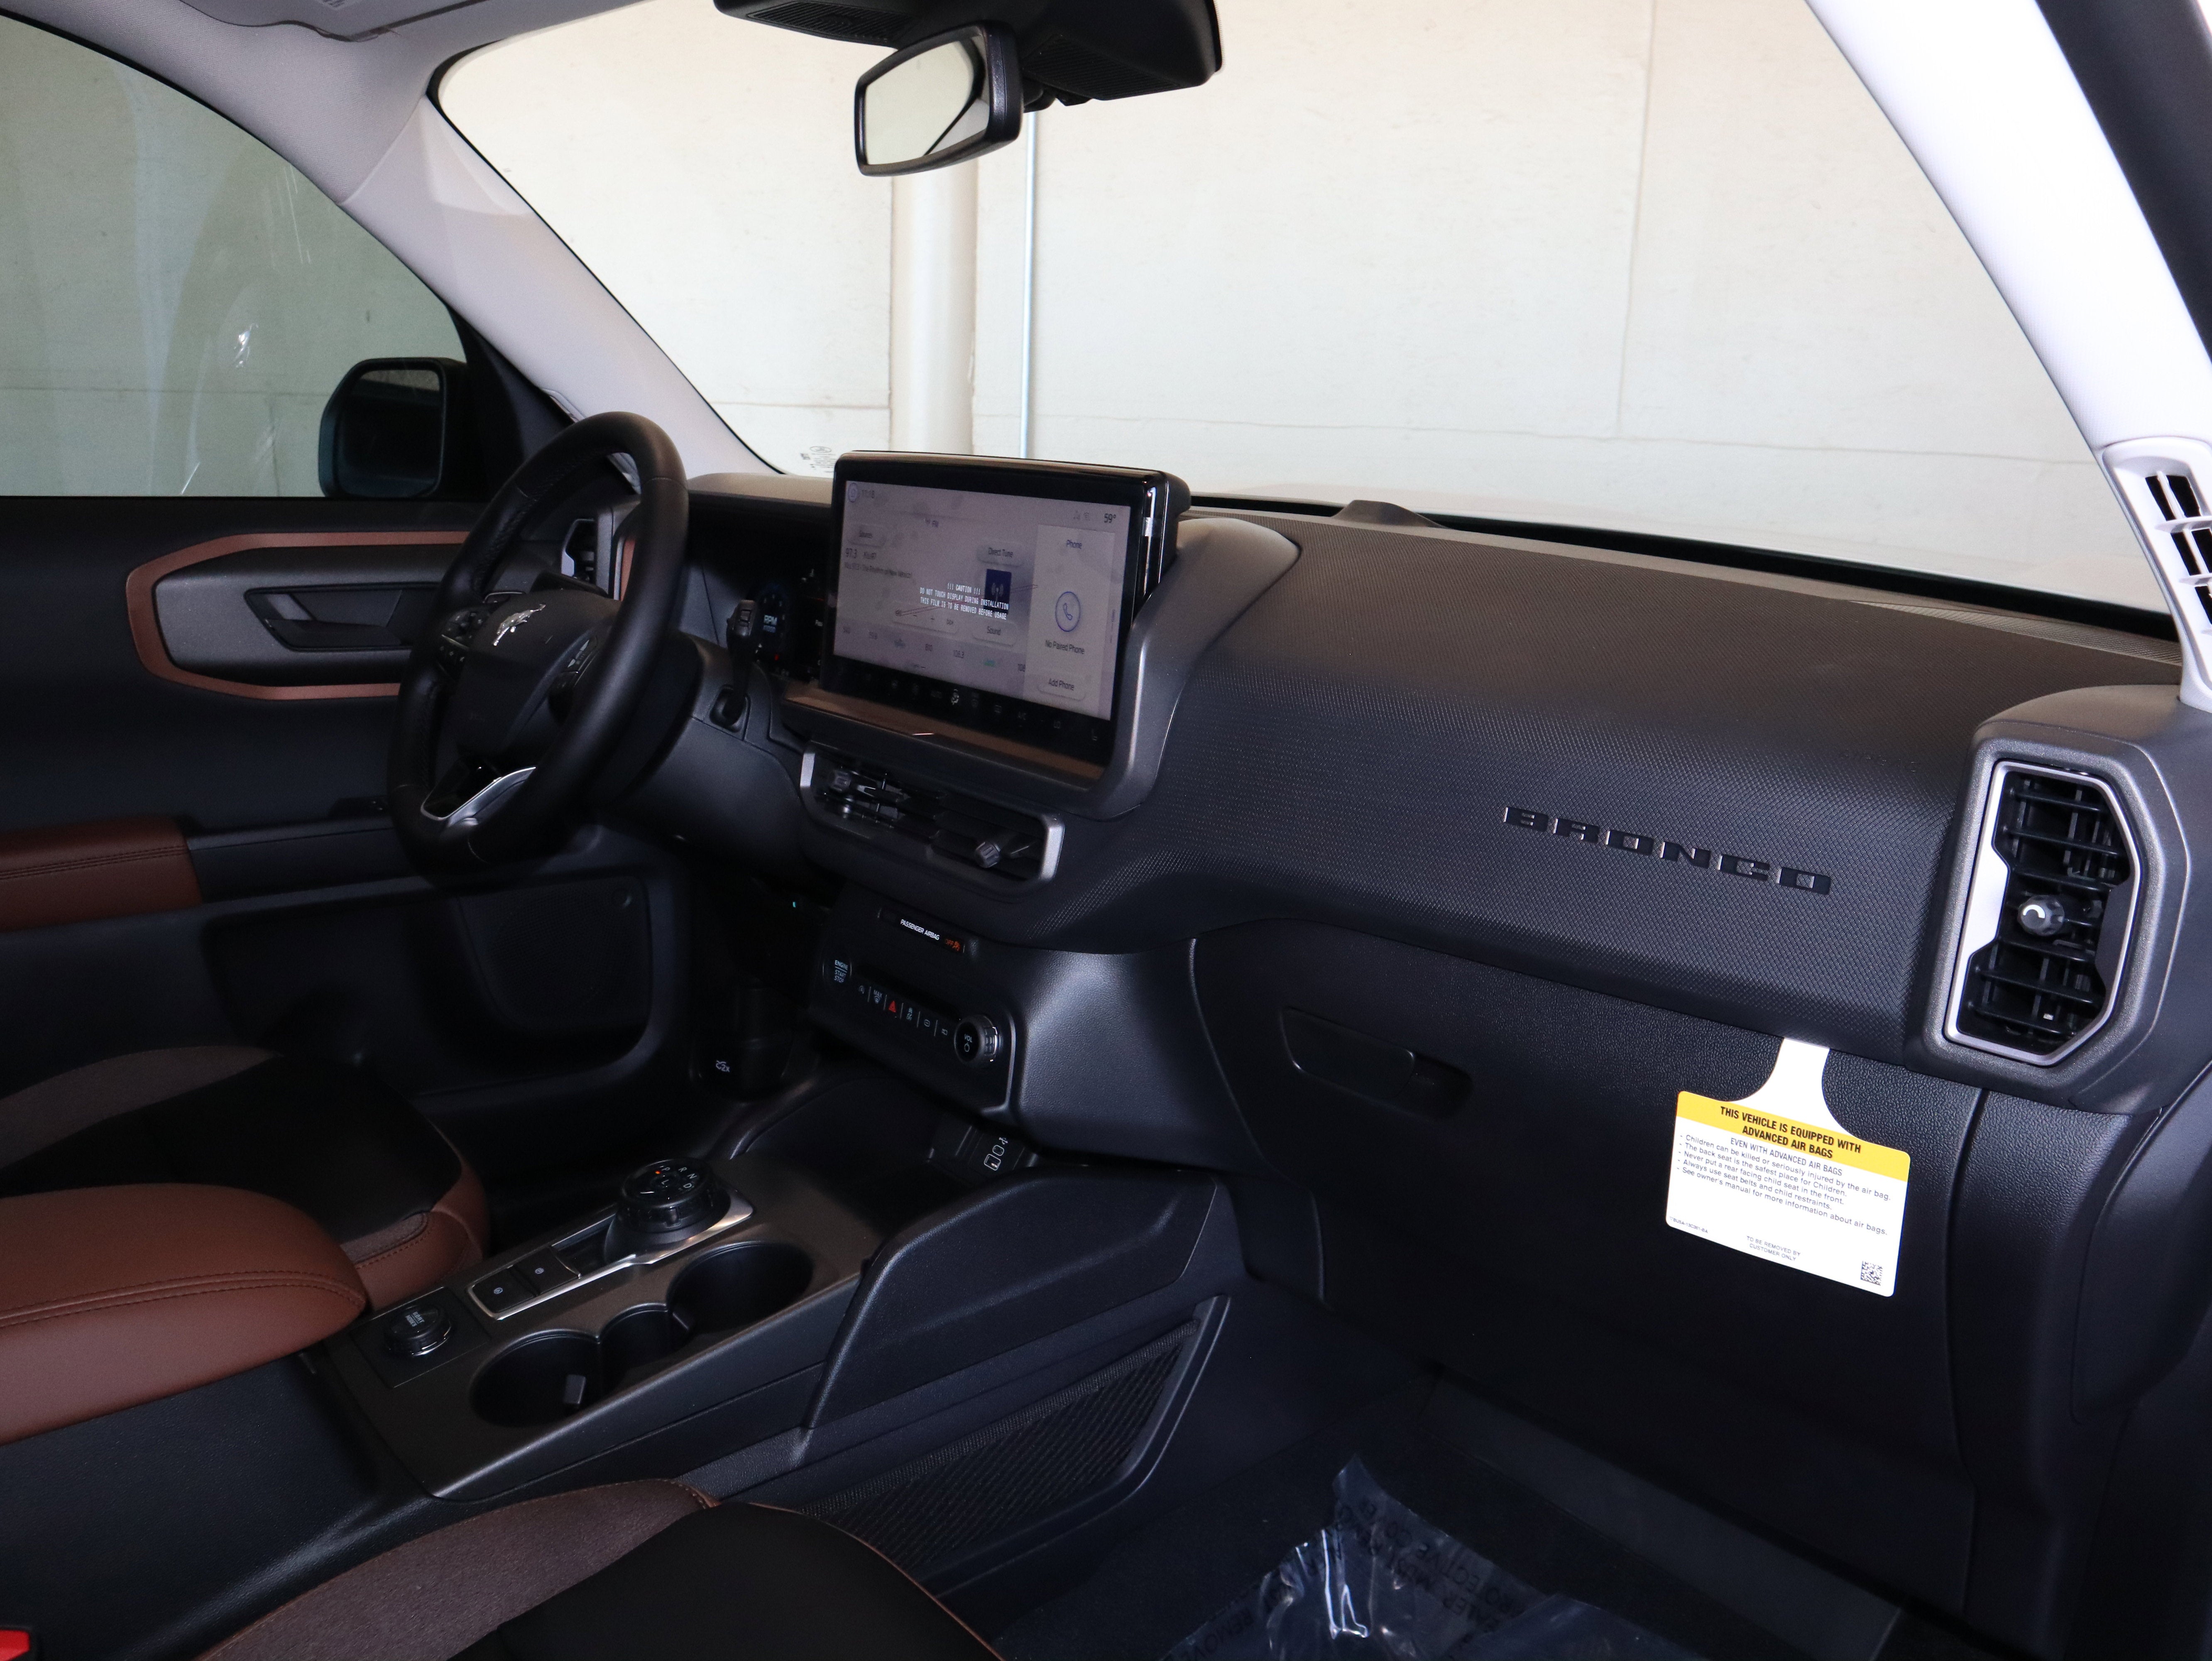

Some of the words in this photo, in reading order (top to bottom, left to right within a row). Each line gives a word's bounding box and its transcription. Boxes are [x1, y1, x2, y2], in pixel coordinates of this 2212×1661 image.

[1066, 539, 1082, 549] Phone
[956, 584, 972, 593] CAUTION
[935, 590, 946, 598] TOUCH
[947, 593, 964, 601] DISPLAY
[965, 595, 979, 605] DURING
[981, 598, 1009, 610] INSTALLATION
[961, 605, 976, 614] REMOVED
[979, 608, 993, 617] BEFORE
[994, 611, 1007, 620] USAGE
[1069, 644, 1084, 654] Phone
[1048, 678, 1058, 687] Add
[1059, 680, 1074, 691] Phone
[1502, 806, 1832, 895] BRONCO
[900, 919, 924, 934] PASSENGER
[924, 930, 940, 941] AIRBAG
[834, 960, 848, 970] ENGINE
[834, 969, 846, 978] START
[874, 989, 882, 997] MAX
[964, 1033, 973, 1043] VOL
[1720, 1106, 1740, 1119] THIS
[1742, 1112, 1777, 1130] VEHICLE
[1779, 1122, 1788, 1132] IS
[1790, 1126, 1834, 1146] EQUIPPED
[1837, 1139, 1862, 1153] WITH
[1742, 1125, 1789, 1146] ADVANCED
[1791, 1139, 1806, 1151] AIR
[1809, 1144, 1833, 1159] BAGS
[1730, 1137, 1748, 1149] EVEN
[1750, 1143, 1768, 1154] WITH
[1770, 1149, 1806, 1165] ADVANCED
[1809, 1161, 1821, 1170] AIR
[1823, 1165, 1843, 1176] BAGS
[1686, 1134, 1714, 1148] Children
[1742, 1152, 1760, 1162] killed
[1772, 1162, 1805, 1176] seriously
[1808, 1171, 1834, 1184] injured
[1836, 1177, 1845, 1188] by
[1848, 1183, 1860, 1191] the
[1874, 1188, 1891, 1201] bag.
[1686, 1142, 1698, 1151] The
[1700, 1147, 1715, 1157] back
[1718, 1154, 1732, 1162] seat
[1755, 1165, 1777, 1176] safest
[1779, 1171, 1798, 1182] place
[1801, 1177, 1811, 1186] for
[1813, 1181, 1847, 1197] Children.
[1683, 1159, 1707, 1171] Always
[1724, 1173, 1738, 1181] seat
[1740, 1177, 1757, 1187] belts
[1775, 1188, 1792, 1198] child
[1795, 1194, 1833, 1210] restraints.
[1684, 1151, 1704, 1162] Never
[1725, 1164, 1738, 1173] rear
[1740, 1168, 1762, 1181] facing
[1764, 1177, 1781, 1186] child
[1784, 1183, 1799, 1191] seat
[1801, 1186, 1808, 1194] in
[1811, 1190, 1822, 1198] the
[1824, 1193, 1844, 1205] front.
[1683, 1167, 1695, 1176] See
[1697, 1173, 1723, 1185] owner's
[1725, 1181, 1751, 1194] manual
[1765, 1194, 1783, 1203] more
[1785, 1200, 1828, 1217] information
[1830, 1213, 1852, 1225] about
[1866, 1223, 1888, 1236] bags.
[1749, 1243, 1780, 1257] CUSTOMER
[1781, 1253, 1796, 1262] ONLY
[1764, 1242, 1791, 1254] REMOVED
